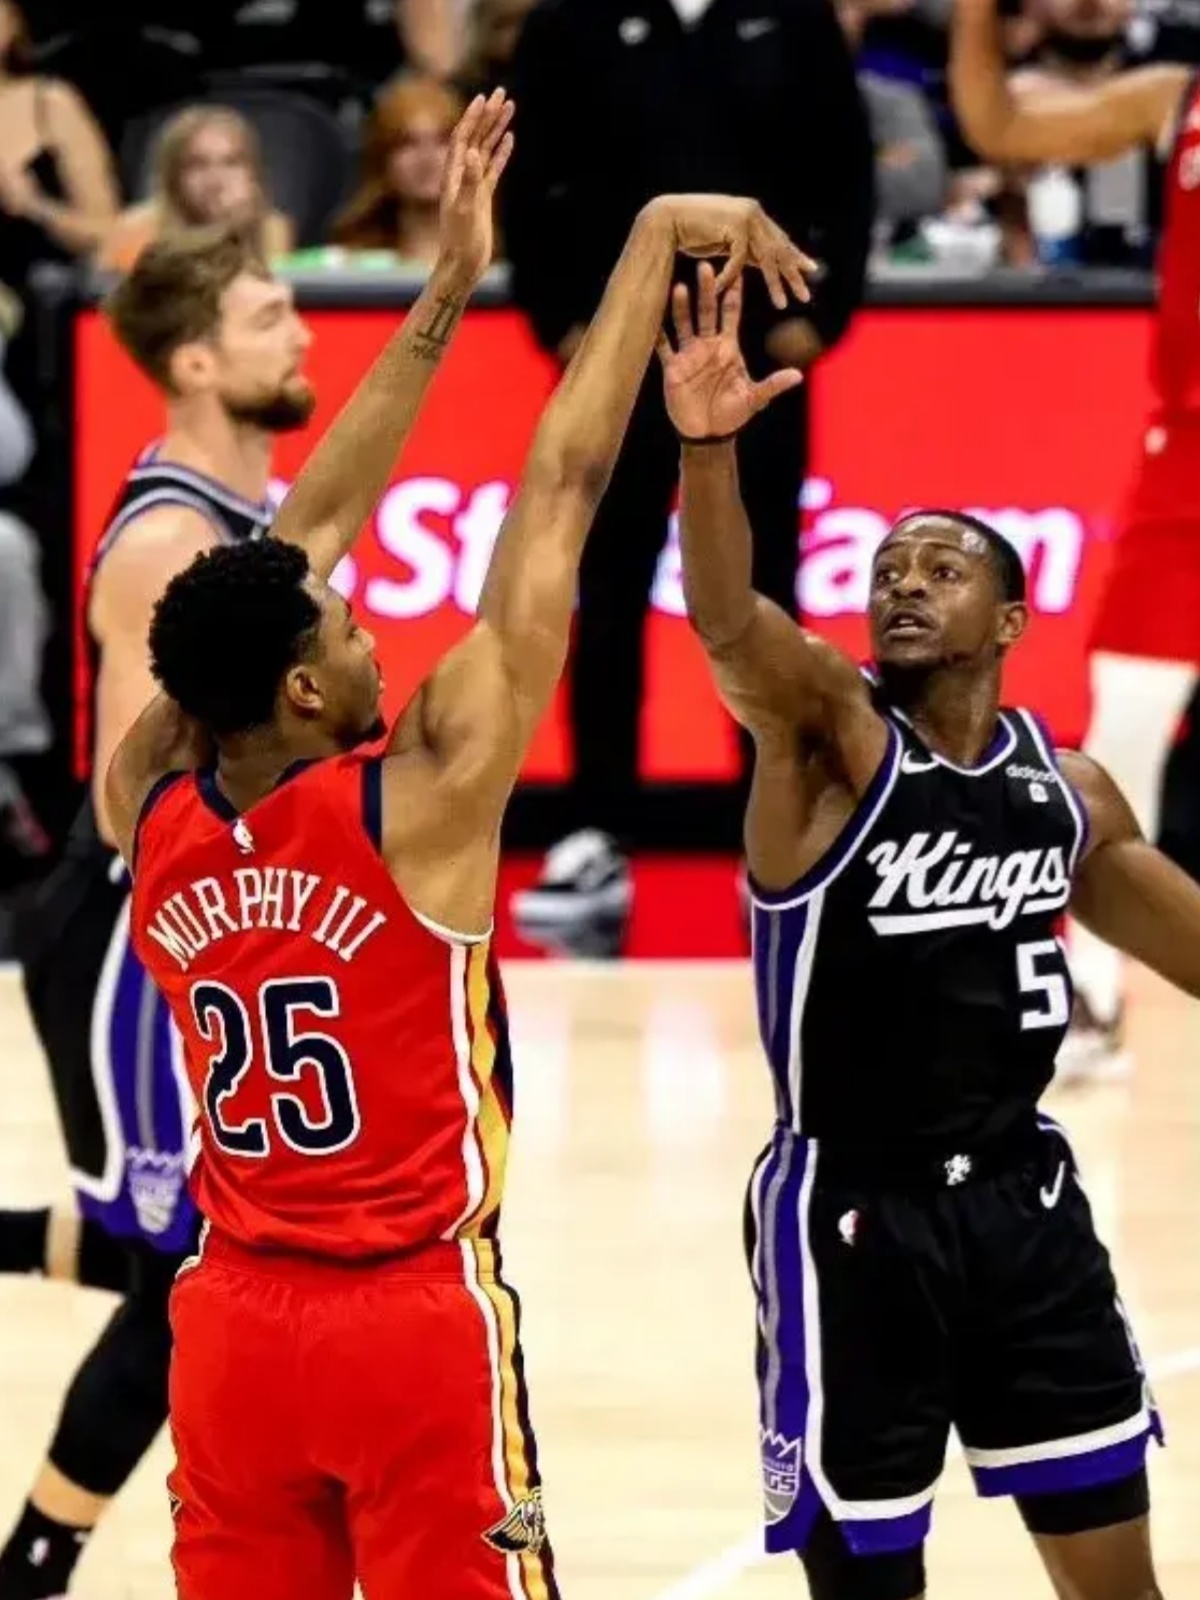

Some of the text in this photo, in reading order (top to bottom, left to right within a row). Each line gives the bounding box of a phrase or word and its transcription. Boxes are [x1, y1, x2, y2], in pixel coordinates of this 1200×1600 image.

[147, 866, 387, 972] MURPHY III
[866, 831, 1071, 936] Kings
[1016, 938, 1069, 1030] 5
[189, 975, 362, 1158] 25
